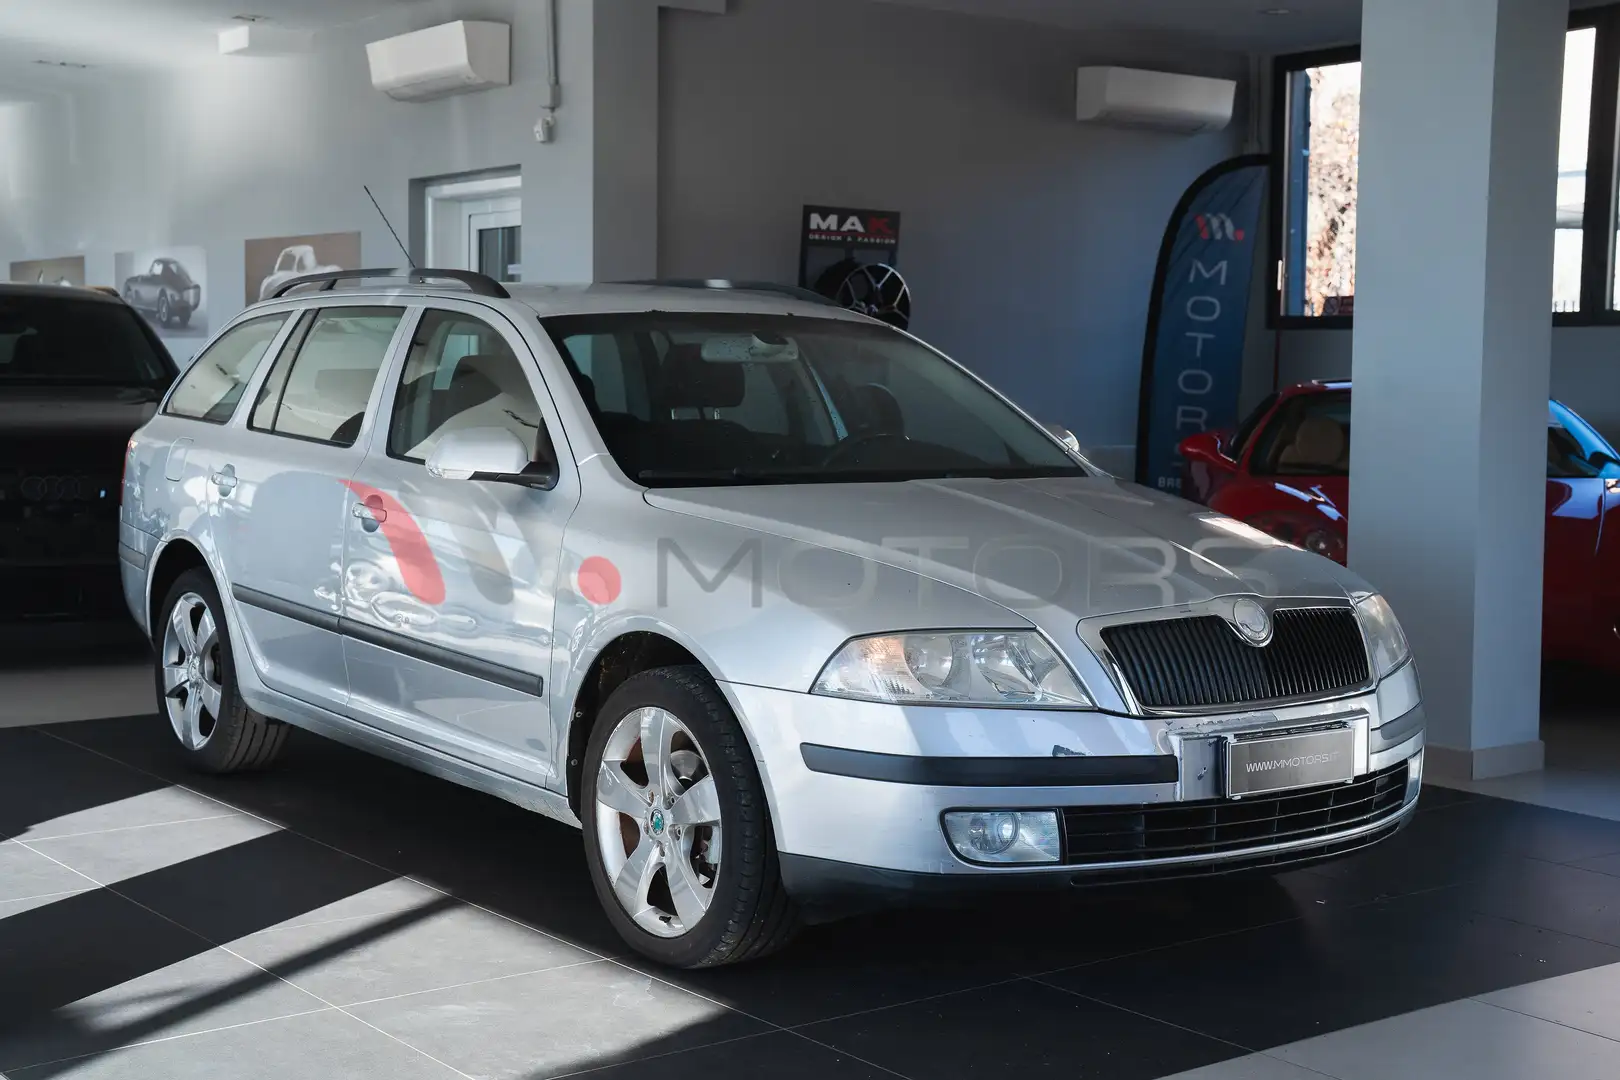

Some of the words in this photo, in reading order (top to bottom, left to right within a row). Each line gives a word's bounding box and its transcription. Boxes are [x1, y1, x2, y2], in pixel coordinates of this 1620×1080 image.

[809, 212, 892, 234] MAK
[808, 233, 842, 241] DESIGN
[857, 236, 896, 244] PASSION
[1171, 258, 1228, 466] MOTOR
[1245, 751, 1340, 773] WWW.MMOTORS.IT
